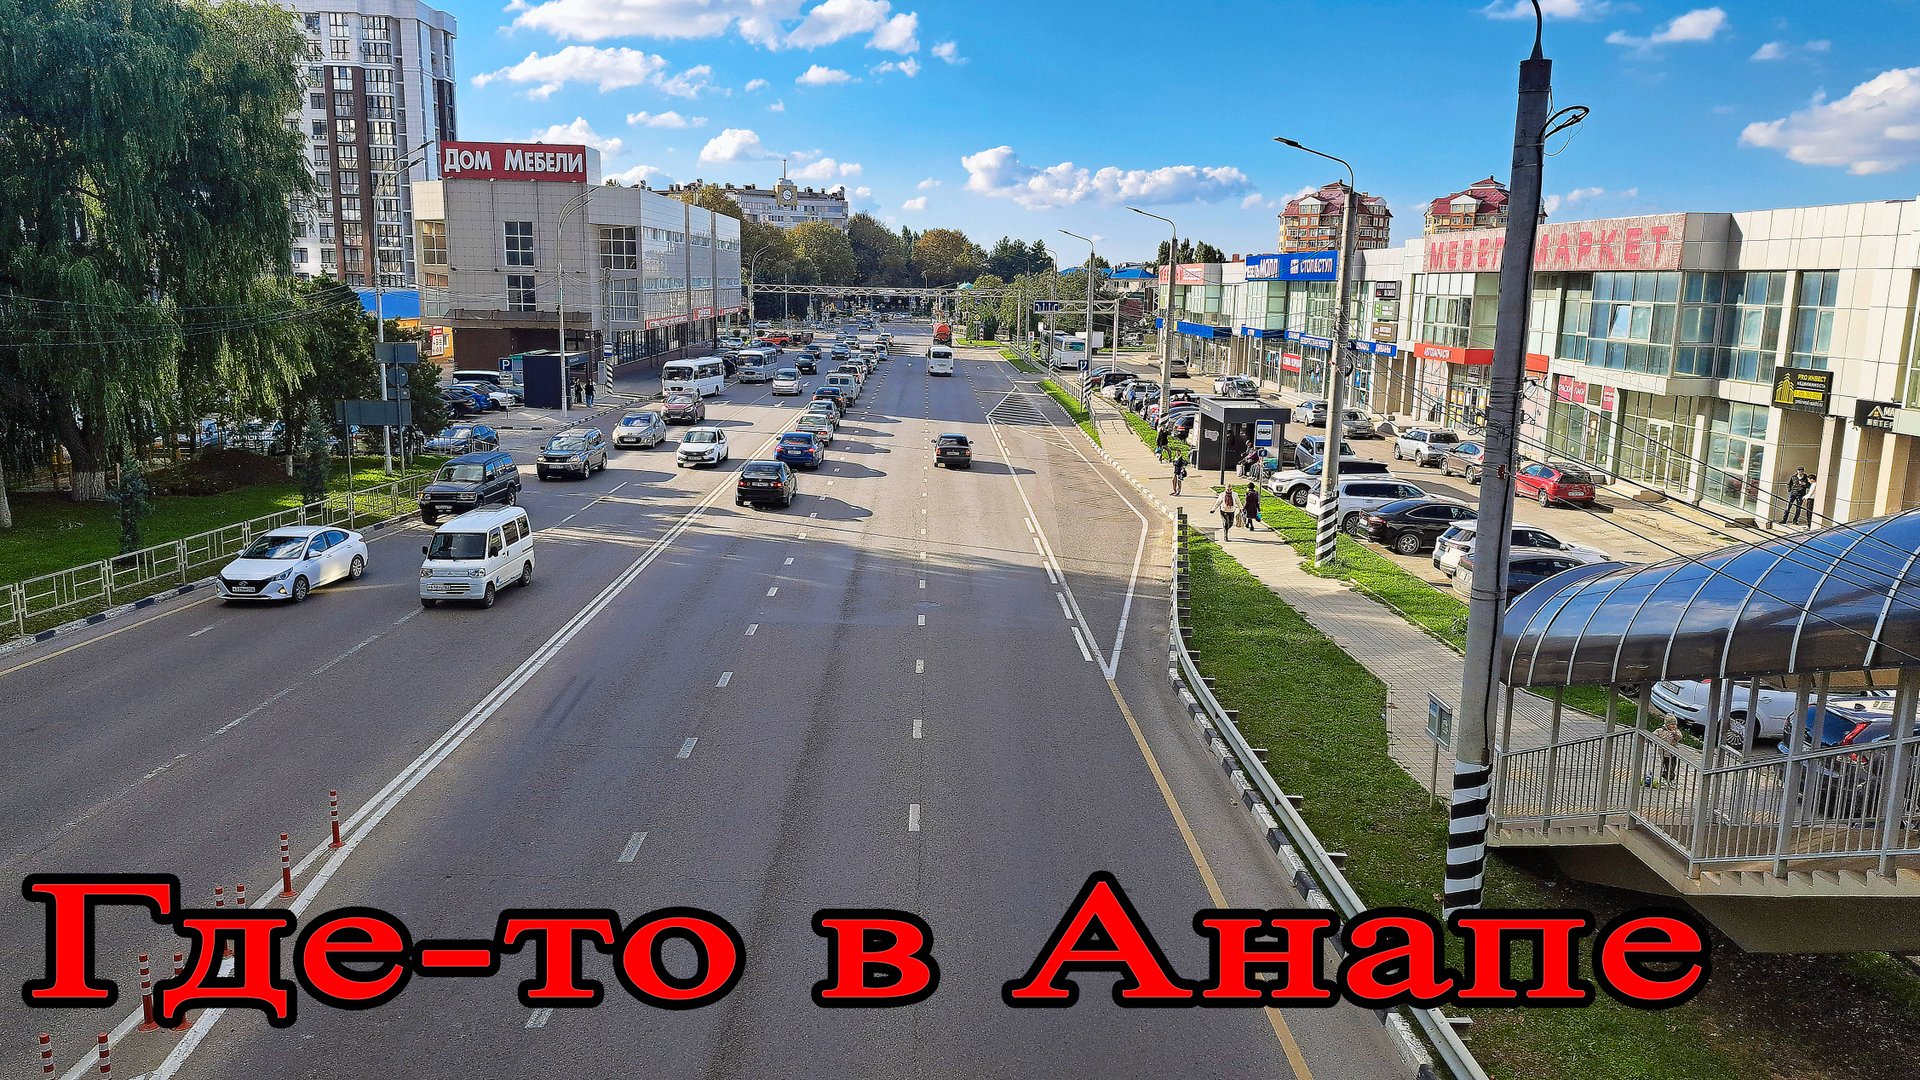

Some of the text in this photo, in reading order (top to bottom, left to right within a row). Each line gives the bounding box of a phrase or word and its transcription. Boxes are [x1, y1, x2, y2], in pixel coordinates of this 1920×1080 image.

[444, 148, 583, 173] ДОМ МЕБЕЛИ
[1430, 225, 1670, 269] МЕБЕ МАРКЕТ
